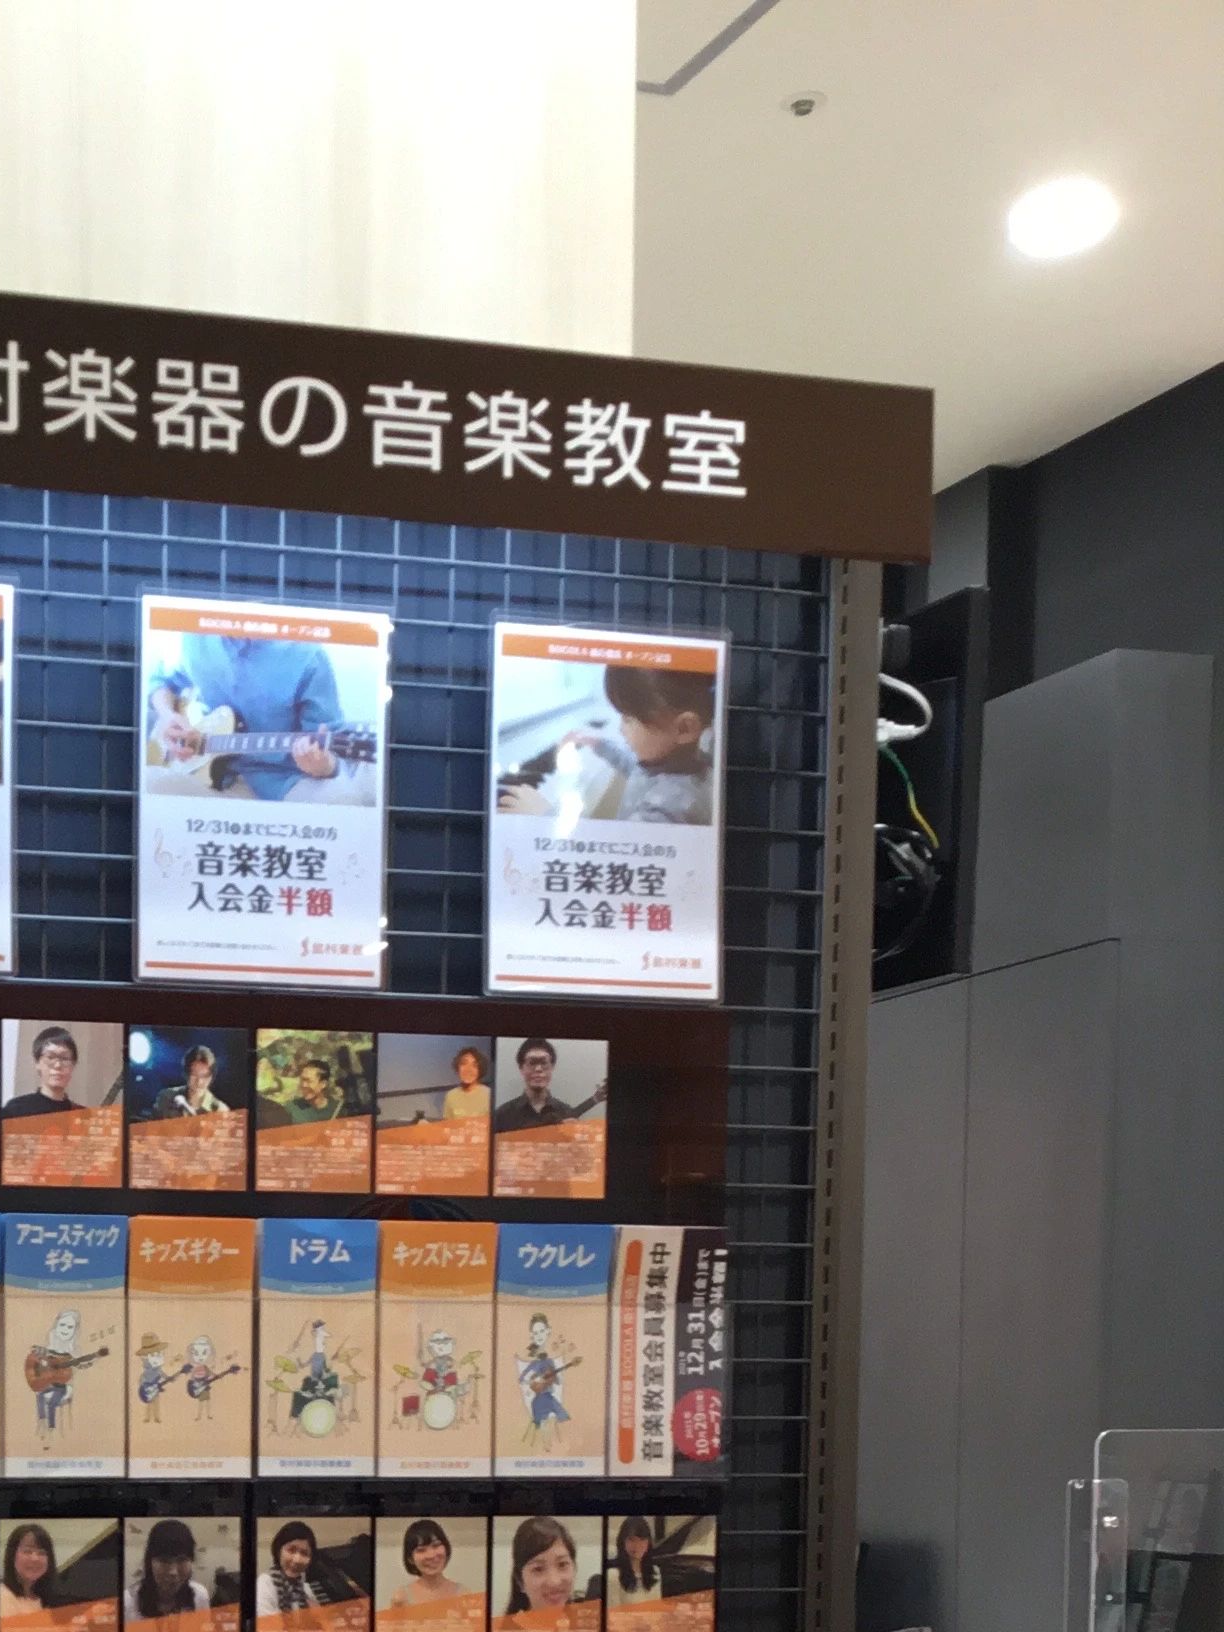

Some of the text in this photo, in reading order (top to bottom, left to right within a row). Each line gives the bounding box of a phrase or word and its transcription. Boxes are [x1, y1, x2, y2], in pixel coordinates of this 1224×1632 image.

[195, 841, 327, 882] 音楽教室
[542, 859, 667, 898] 音楽教室
[16, 1222, 121, 1247] アコースティック
[45, 1248, 89, 1272] ギター
[138, 1237, 240, 1265] キッズギター
[290, 1237, 351, 1265] ドラム
[393, 1241, 488, 1268] キッズドラム
[518, 1242, 597, 1269] ウクレレ
[641, 1242, 671, 1461] 音楽教室会員募集中
